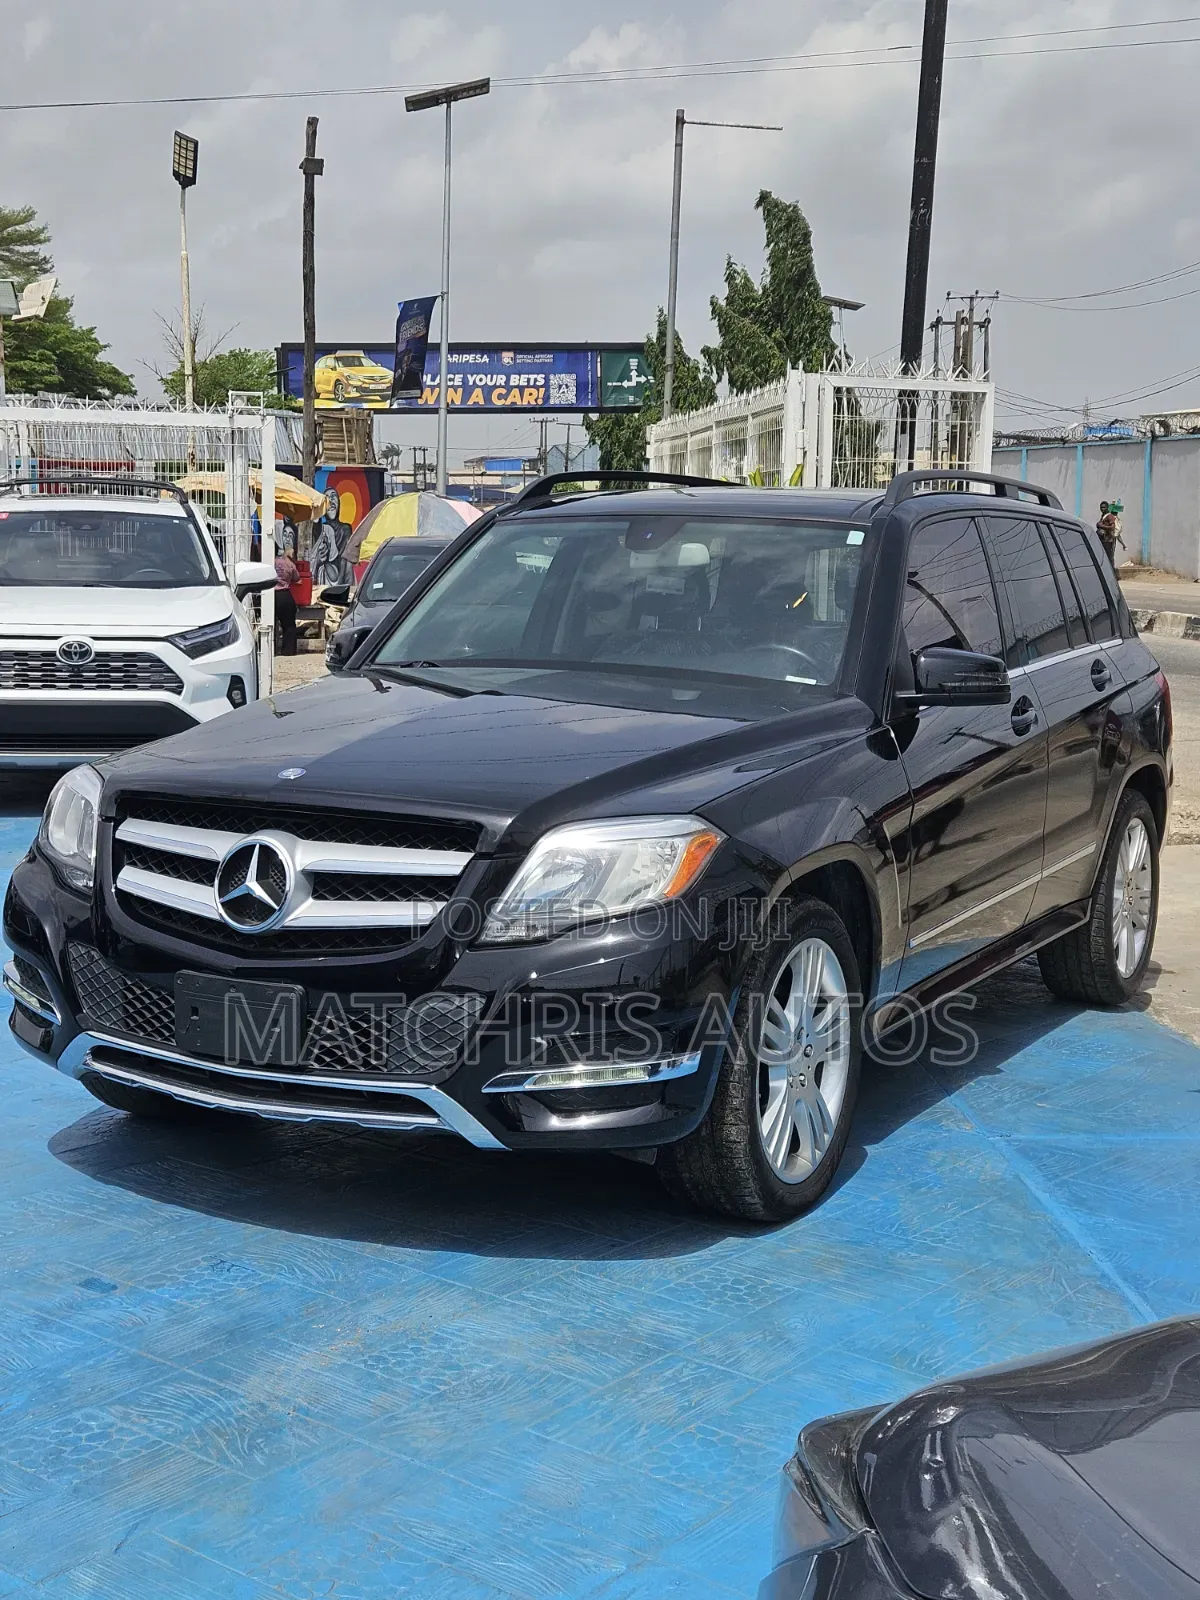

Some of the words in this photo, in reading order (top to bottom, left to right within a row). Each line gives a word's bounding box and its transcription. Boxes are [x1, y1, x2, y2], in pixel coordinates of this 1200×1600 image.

[467, 374, 506, 386] YOUR
[510, 374, 545, 386] BETS
[417, 388, 463, 405] WN
[467, 388, 485, 405] A
[491, 388, 546, 405] CAR!
